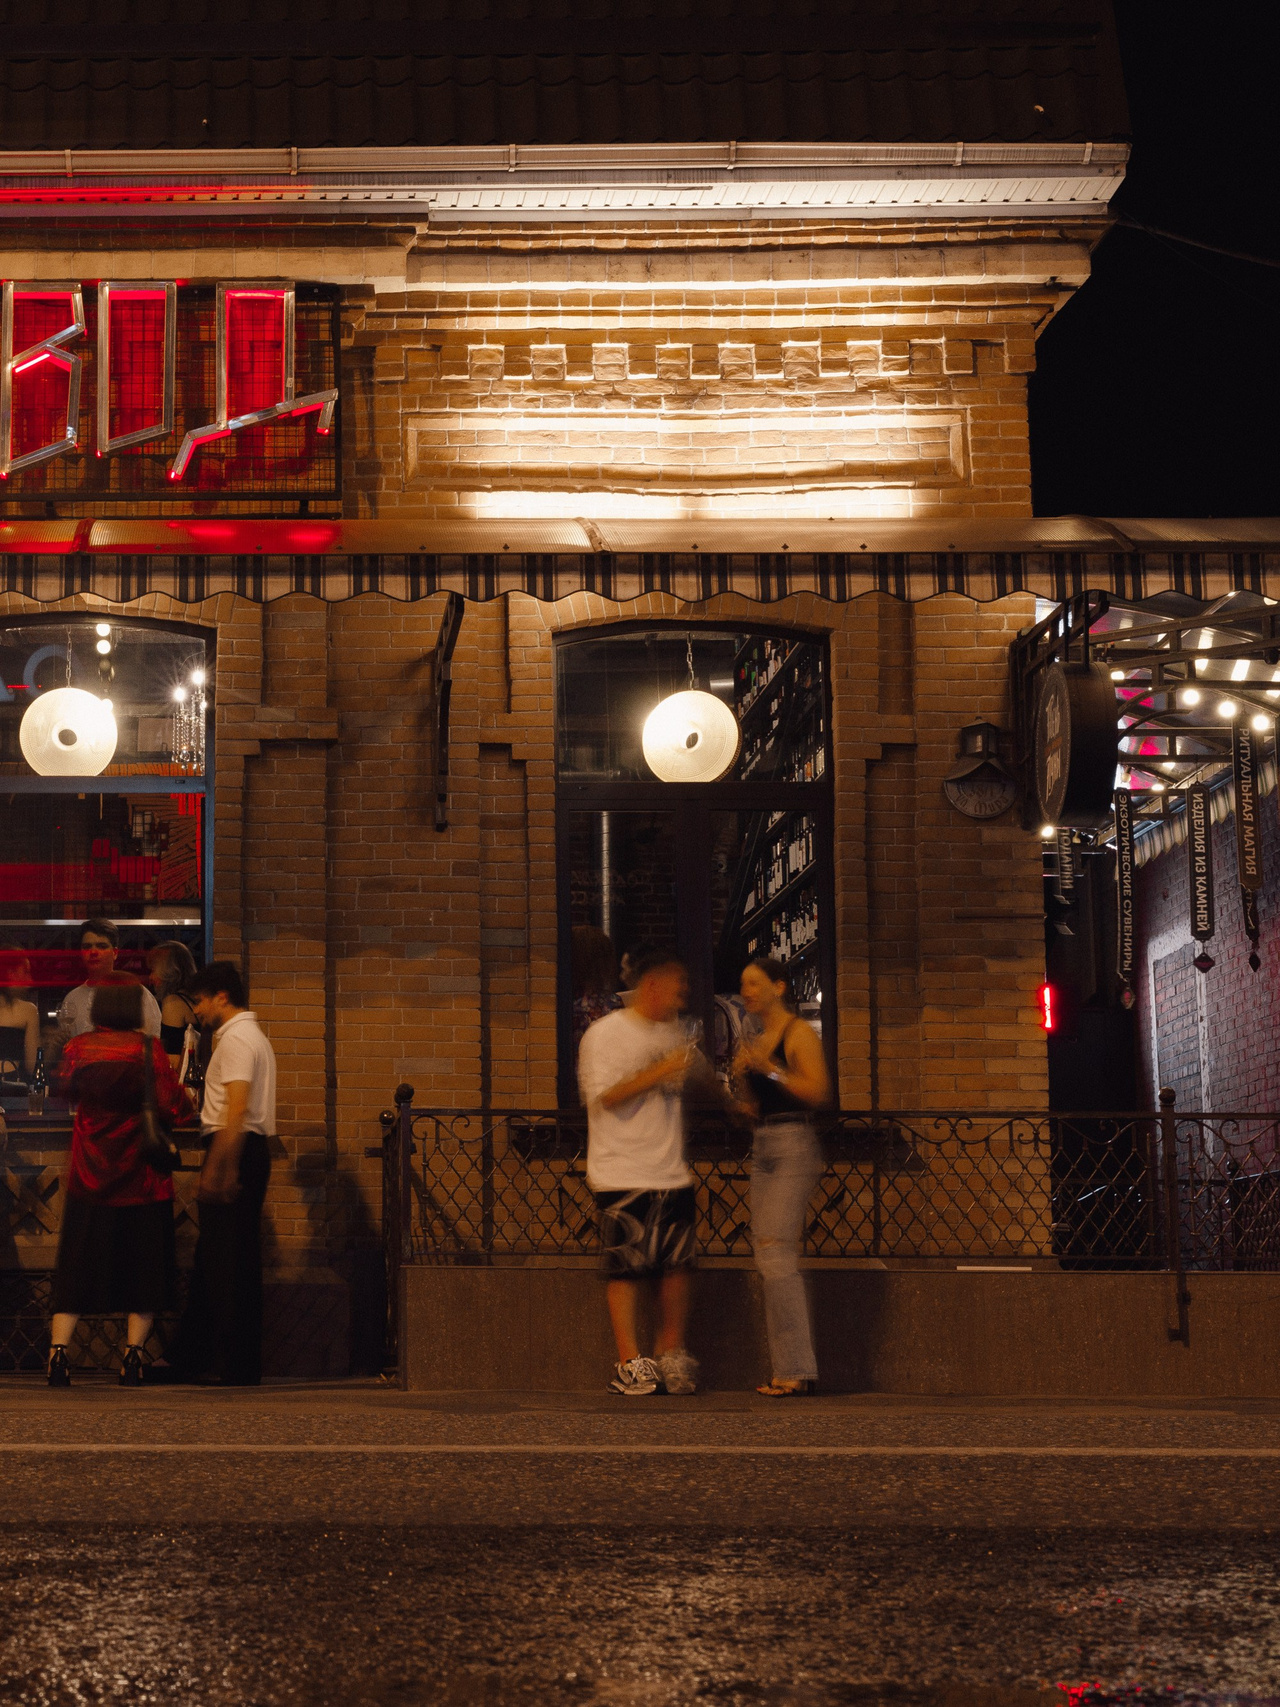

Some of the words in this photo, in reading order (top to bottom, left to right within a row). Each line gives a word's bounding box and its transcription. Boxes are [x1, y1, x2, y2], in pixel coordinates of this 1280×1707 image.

[1238, 727, 1255, 823] РИТУАЛЬНАЯ
[1118, 794, 1132, 897] ЭКЗОТИЧЕСКИЕ
[1191, 792, 1206, 852] ИЗДЕЛИЯ
[1243, 825, 1257, 876] МАГИЯ
[1194, 855, 1207, 874] ИЗ
[1195, 876, 1210, 932] КАМНЕЙ
[1123, 899, 1133, 972] СУВЕНИРЫ
